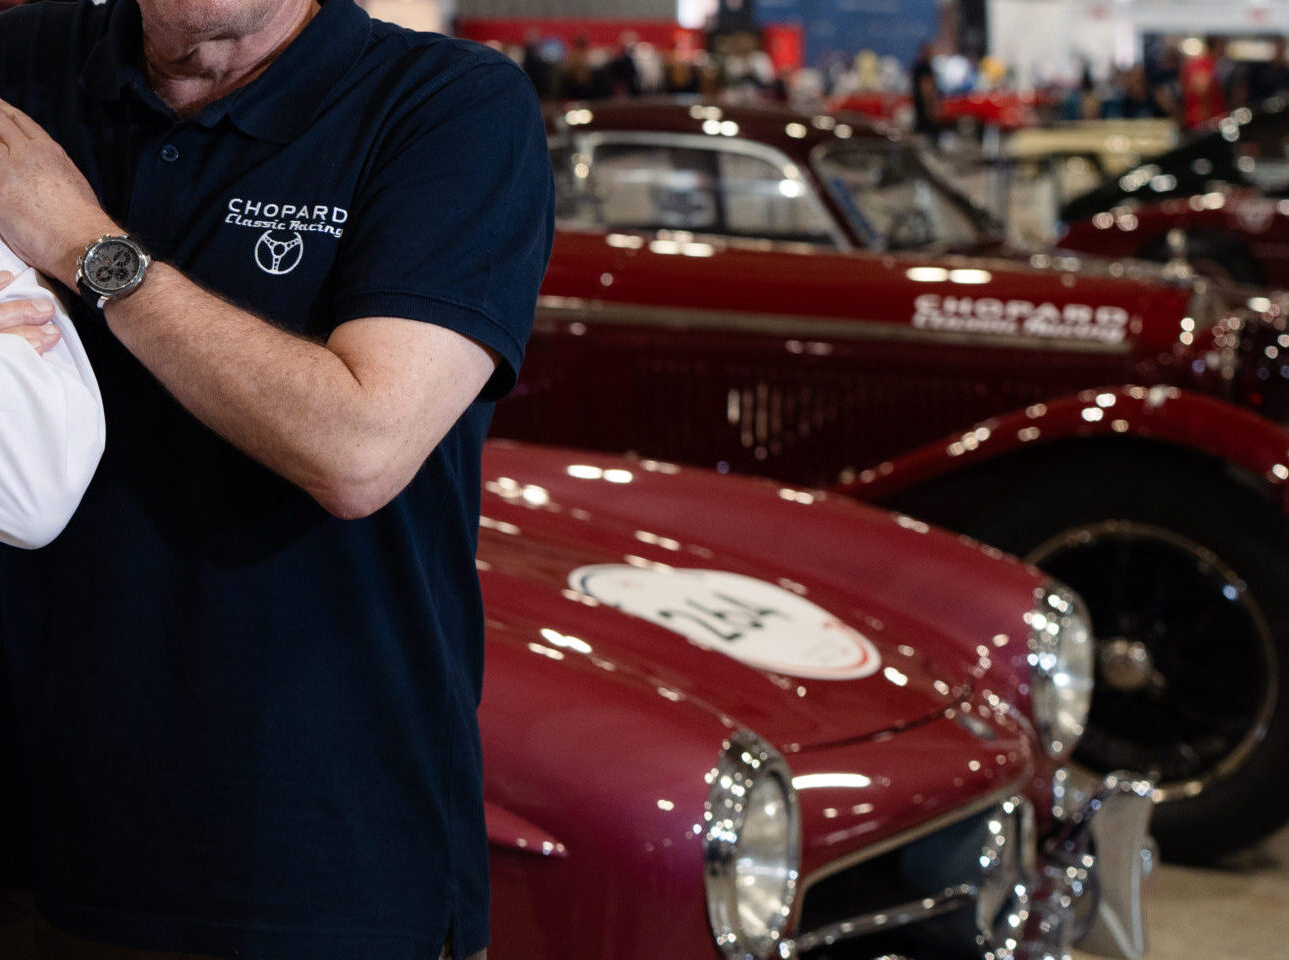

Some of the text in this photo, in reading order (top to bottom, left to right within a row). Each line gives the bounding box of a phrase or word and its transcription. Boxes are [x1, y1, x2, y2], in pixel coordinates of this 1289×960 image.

[228, 198, 348, 223] CHOPARD
[225, 213, 344, 238] Classic Racing
